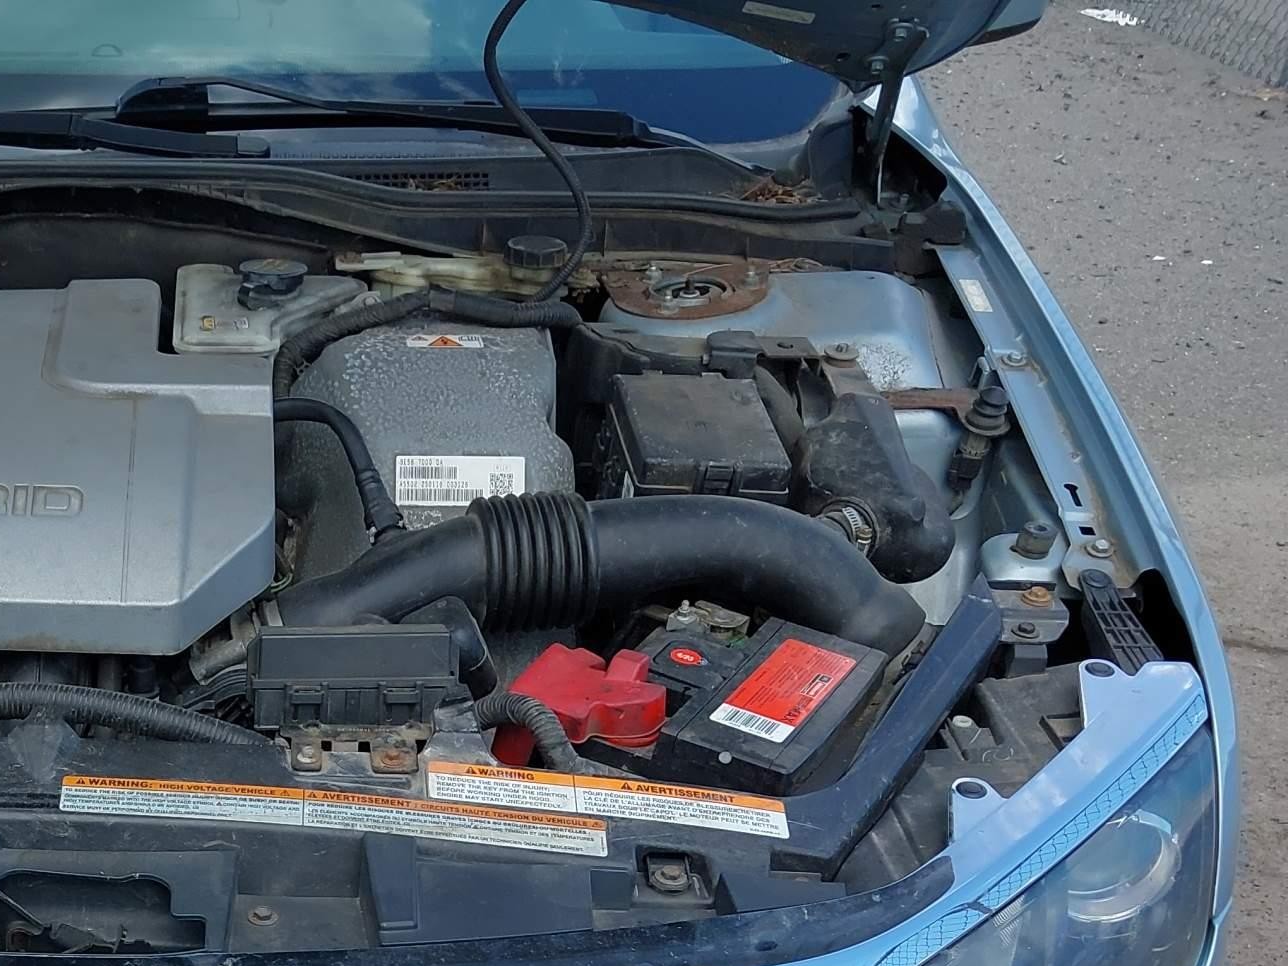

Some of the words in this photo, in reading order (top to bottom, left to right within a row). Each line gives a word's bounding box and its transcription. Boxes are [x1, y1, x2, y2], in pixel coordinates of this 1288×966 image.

[447, 776, 478, 784] REDUCE
[478, 768, 535, 781] WARNING
[88, 779, 153, 788] WARNING:
[186, 784, 231, 793] VOLTAGE
[233, 787, 275, 795] VEHICLE
[436, 781, 467, 789] REMOVE
[436, 786, 465, 794] BEFORE
[467, 789, 501, 797] WORKING
[436, 791, 463, 799] ENGINE
[635, 783, 736, 803] AVERTISSEMENT
[322, 793, 411, 808] AVERTISSEMENT
[421, 803, 460, 813] CIRCUITS
[462, 807, 490, 816] HAUTE
[493, 811, 529, 820] TENSION
